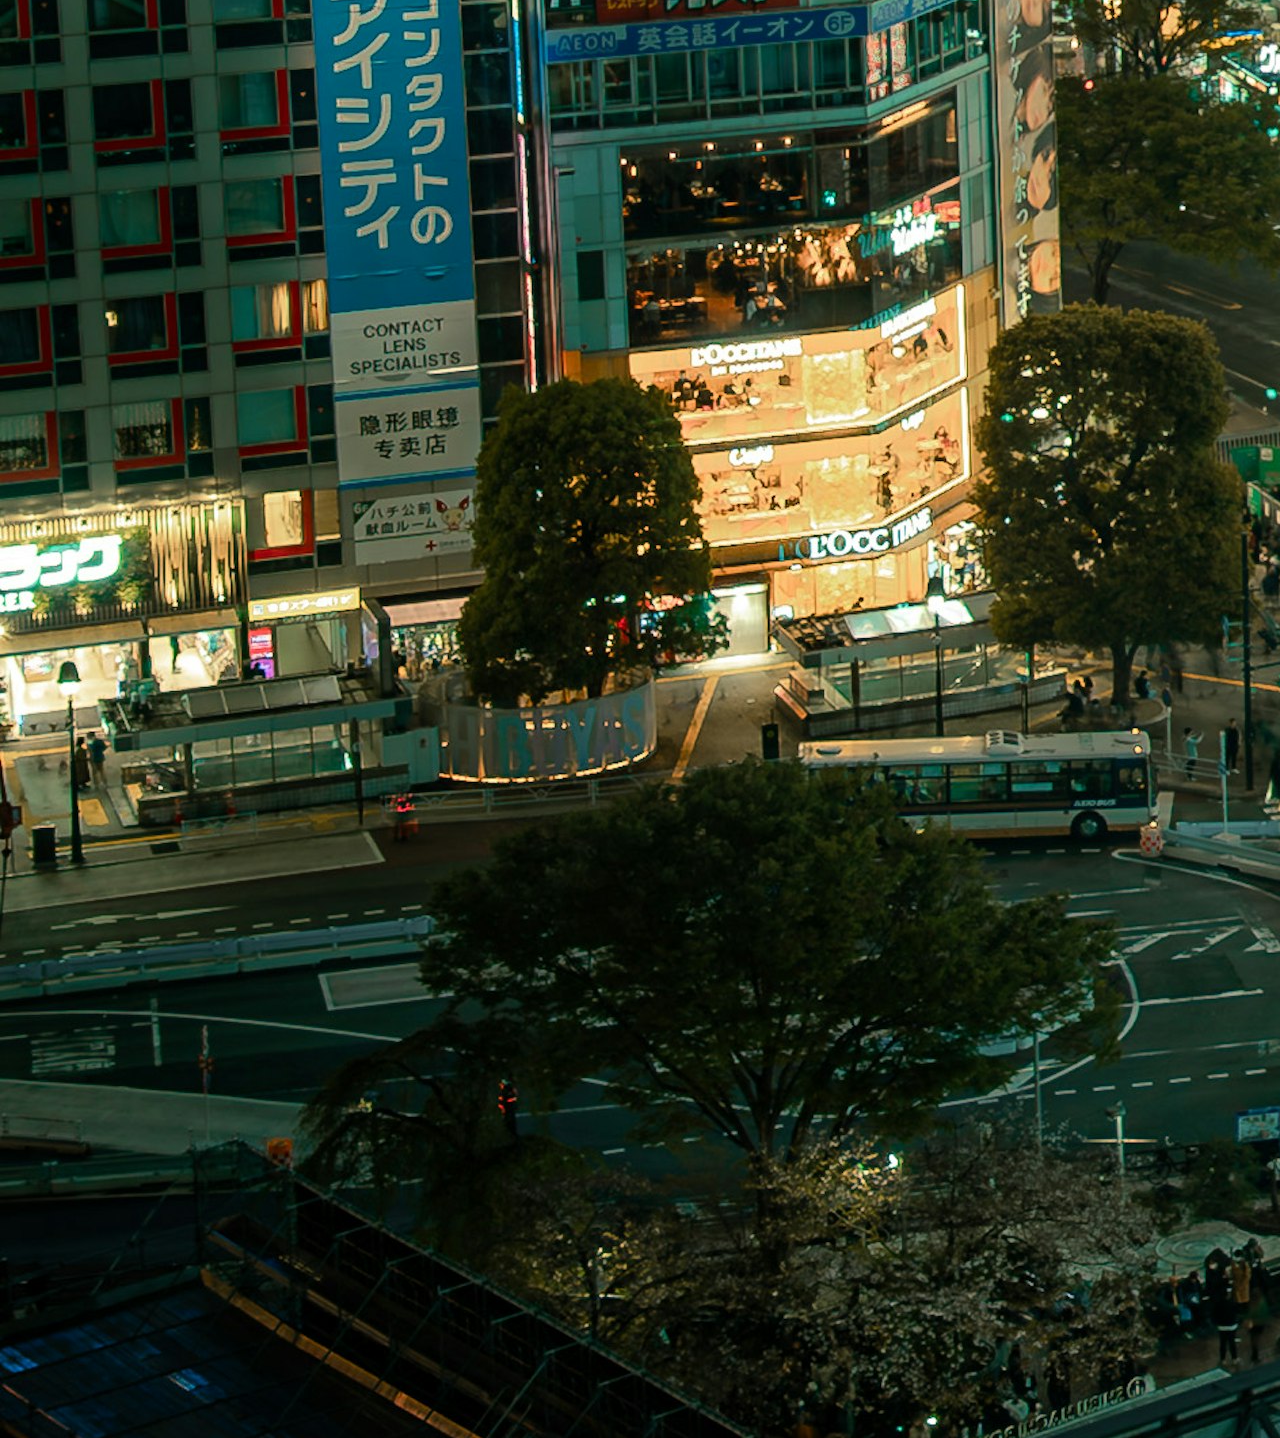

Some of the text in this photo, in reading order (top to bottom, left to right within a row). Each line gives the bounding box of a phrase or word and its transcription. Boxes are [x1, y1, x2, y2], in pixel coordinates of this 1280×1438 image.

[558, 32, 617, 55] AEON
[636, 15, 815, 51] 英会話イーオン
[363, 316, 445, 339] CONTACT
[383, 337, 428, 355] LENS
[349, 350, 462, 376] SPECIALISTS
[359, 405, 462, 438] 隐形眼镜
[373, 433, 447, 461] 专卖店
[370, 501, 432, 521] ハチ公前
[365, 518, 438, 538] 献血ルーム
[810, 507, 933, 559] L'OCCITANE
